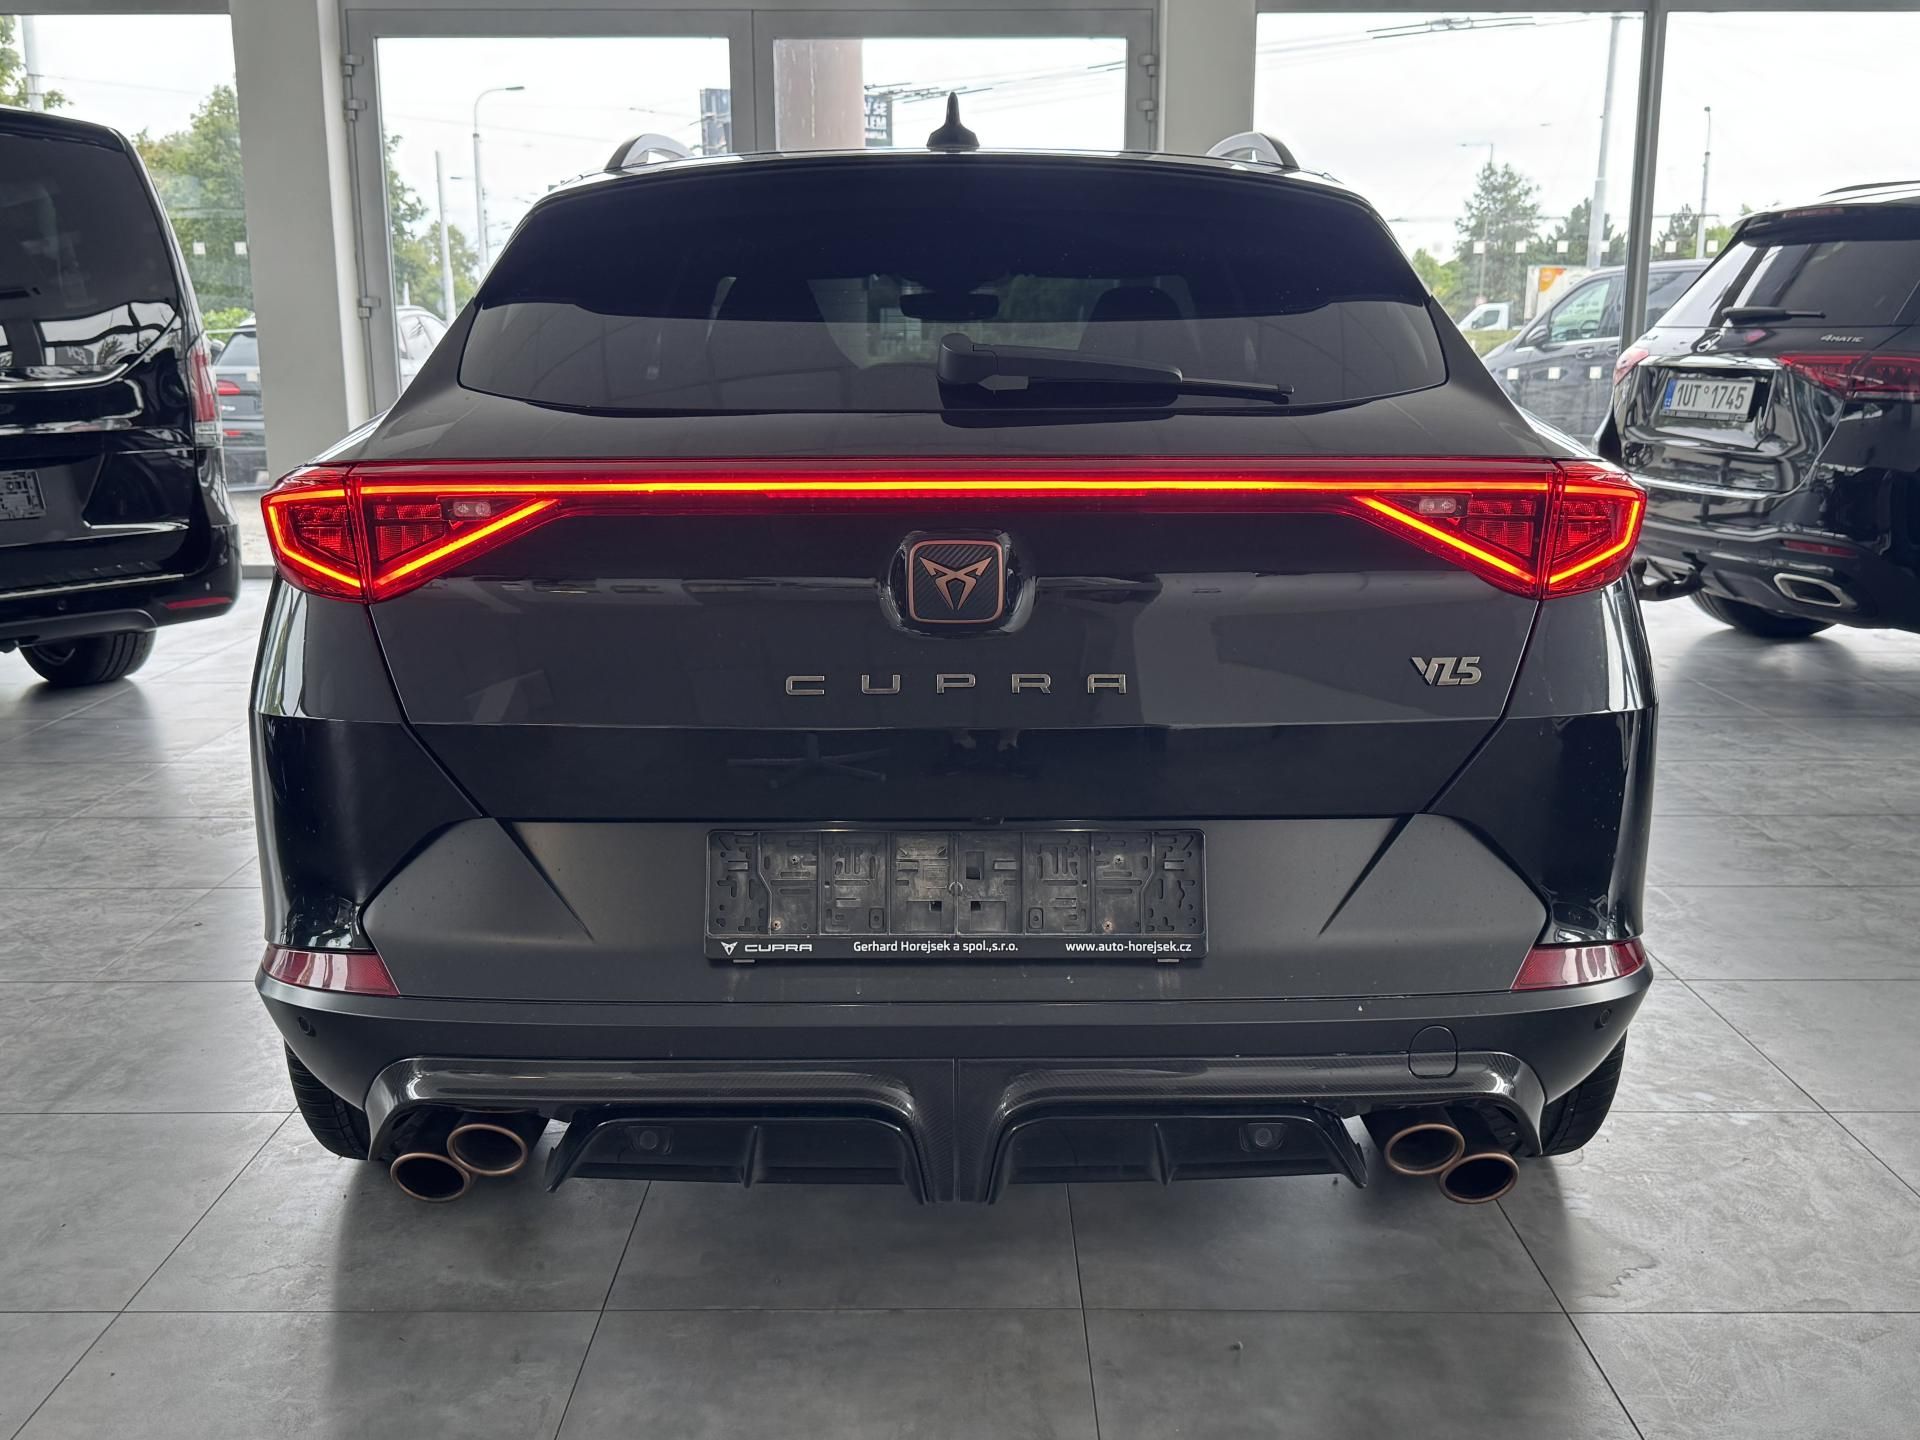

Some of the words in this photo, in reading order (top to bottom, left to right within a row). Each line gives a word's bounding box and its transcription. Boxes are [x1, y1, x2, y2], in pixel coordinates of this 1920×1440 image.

[1677, 383, 1702, 407] 1UT
[1711, 385, 1748, 410] 1745
[1411, 656, 1482, 686] VZ5
[785, 673, 1128, 695] CUPRA
[744, 943, 813, 952] CUPRA
[853, 940, 898, 952] Gerhard
[900, 940, 951, 954] Horejsek
[953, 943, 961, 952] a
[1065, 940, 1193, 954] www.auto-horejsek.cz
